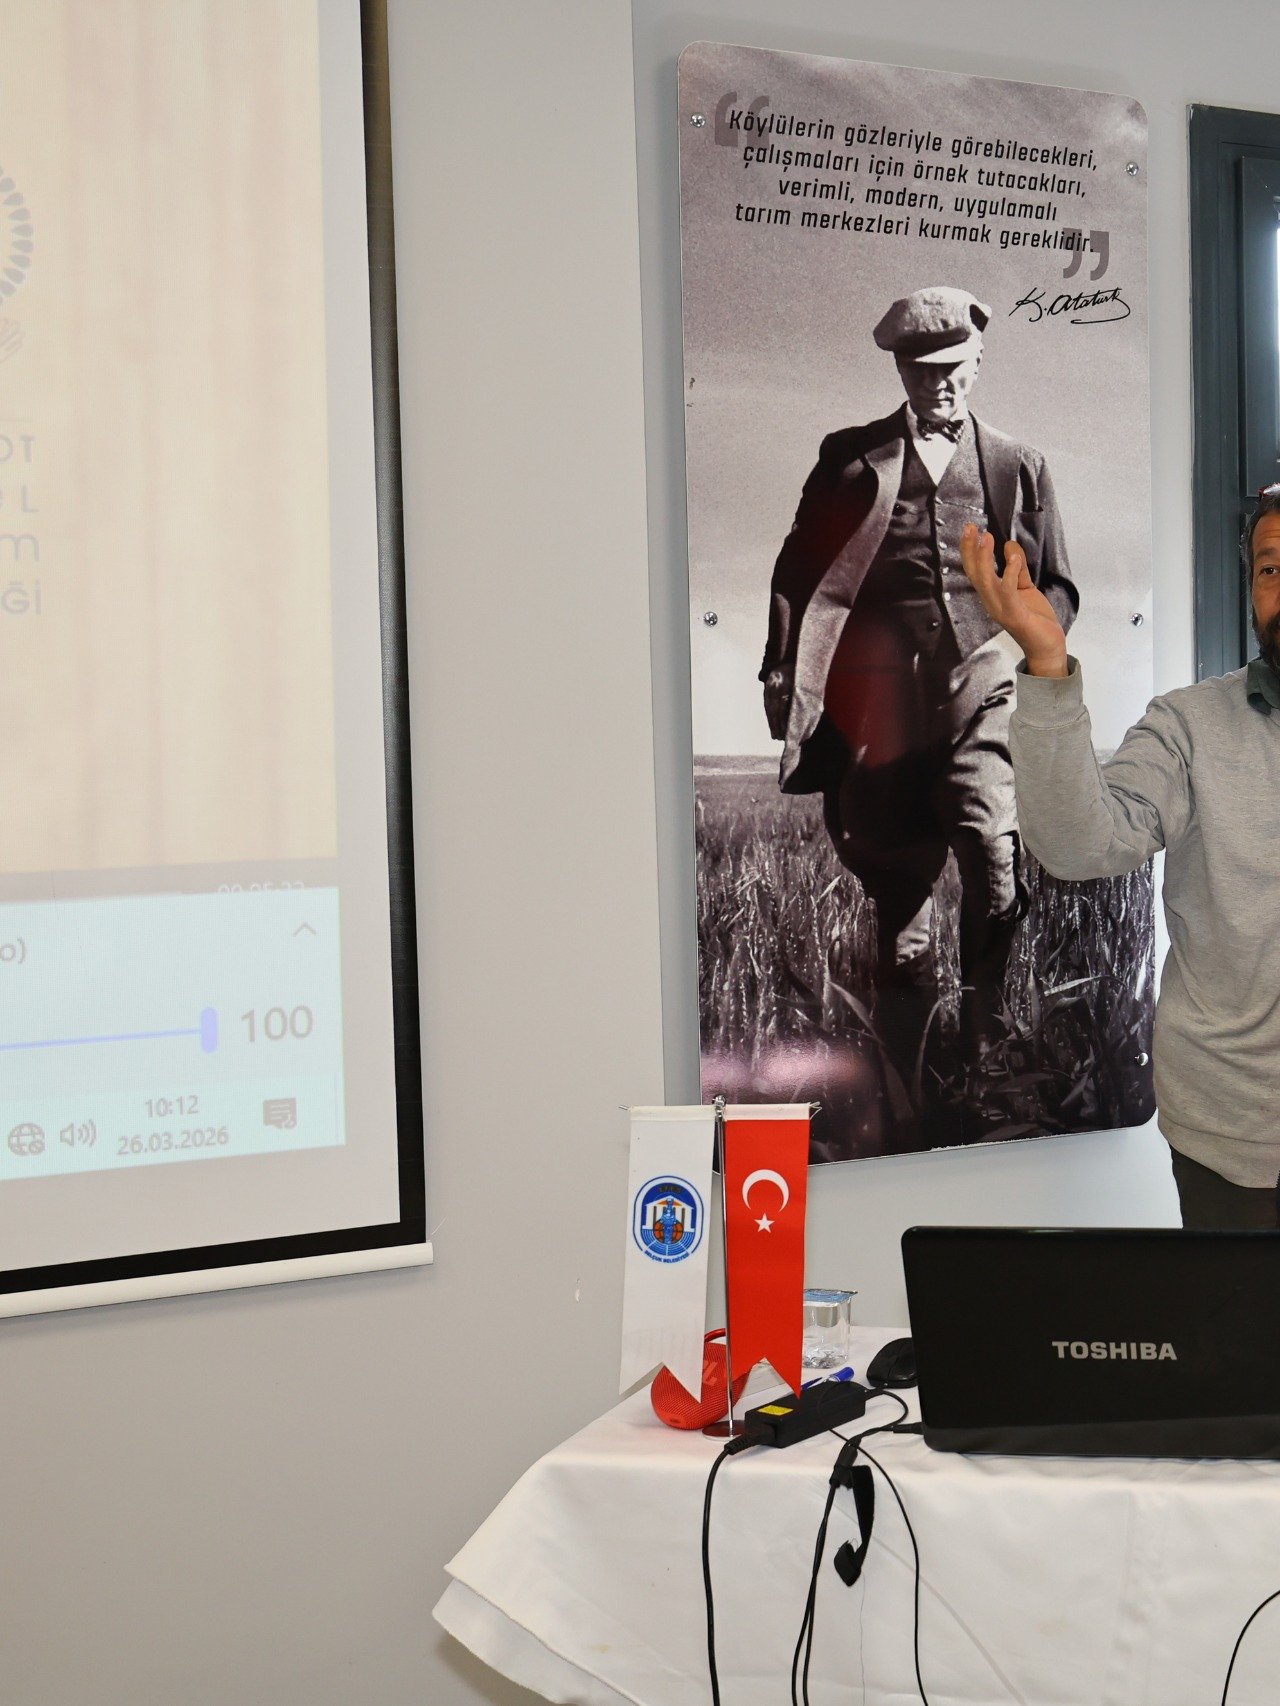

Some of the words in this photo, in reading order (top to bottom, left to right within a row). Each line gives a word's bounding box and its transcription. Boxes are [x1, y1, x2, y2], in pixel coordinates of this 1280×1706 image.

[729, 110, 834, 140] Köylülerin
[844, 124, 942, 154] gözleriyle
[951, 136, 1098, 171] görebilecekleri,
[743, 144, 859, 173] çalışmaları
[868, 154, 904, 182] için
[913, 160, 969, 183] örnek
[977, 168, 1086, 198] tutacakları,
[779, 178, 855, 204] verimli,
[865, 187, 944, 212] modern,
[954, 196, 1057, 221] uygulamalı
[735, 203, 791, 225] tarım
[800, 210, 910, 236] merkezleri
[918, 218, 992, 243] kurmak
[1000, 229, 1094, 253] gereklidir.
[241, 1005, 313, 1042] 100
[144, 1095, 199, 1118] 10:12
[116, 1127, 229, 1156] 26.03.2026
[1051, 1341, 1178, 1361] TOSHIBA
